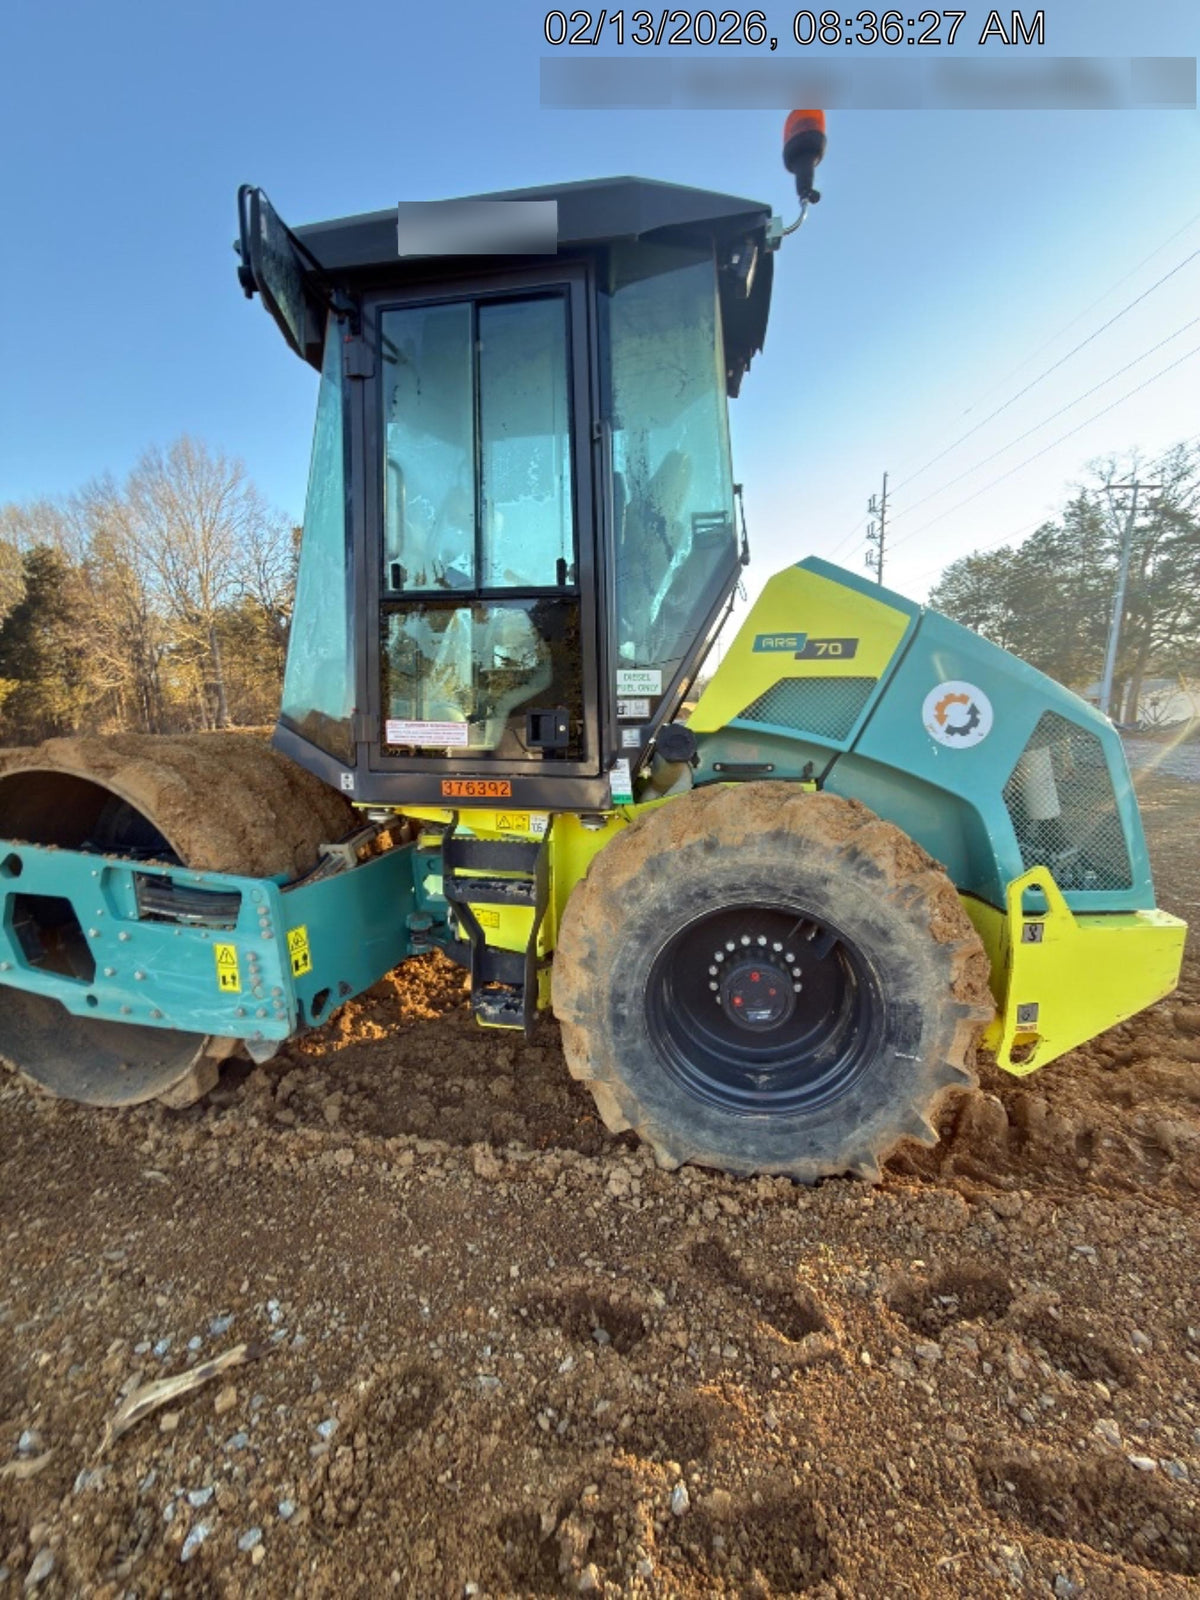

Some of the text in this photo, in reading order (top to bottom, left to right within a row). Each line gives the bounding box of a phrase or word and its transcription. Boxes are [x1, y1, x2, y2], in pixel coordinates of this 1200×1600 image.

[762, 637, 842, 656] ARS 70
[623, 673, 651, 681] DIESEL
[443, 781, 509, 796] 376392
